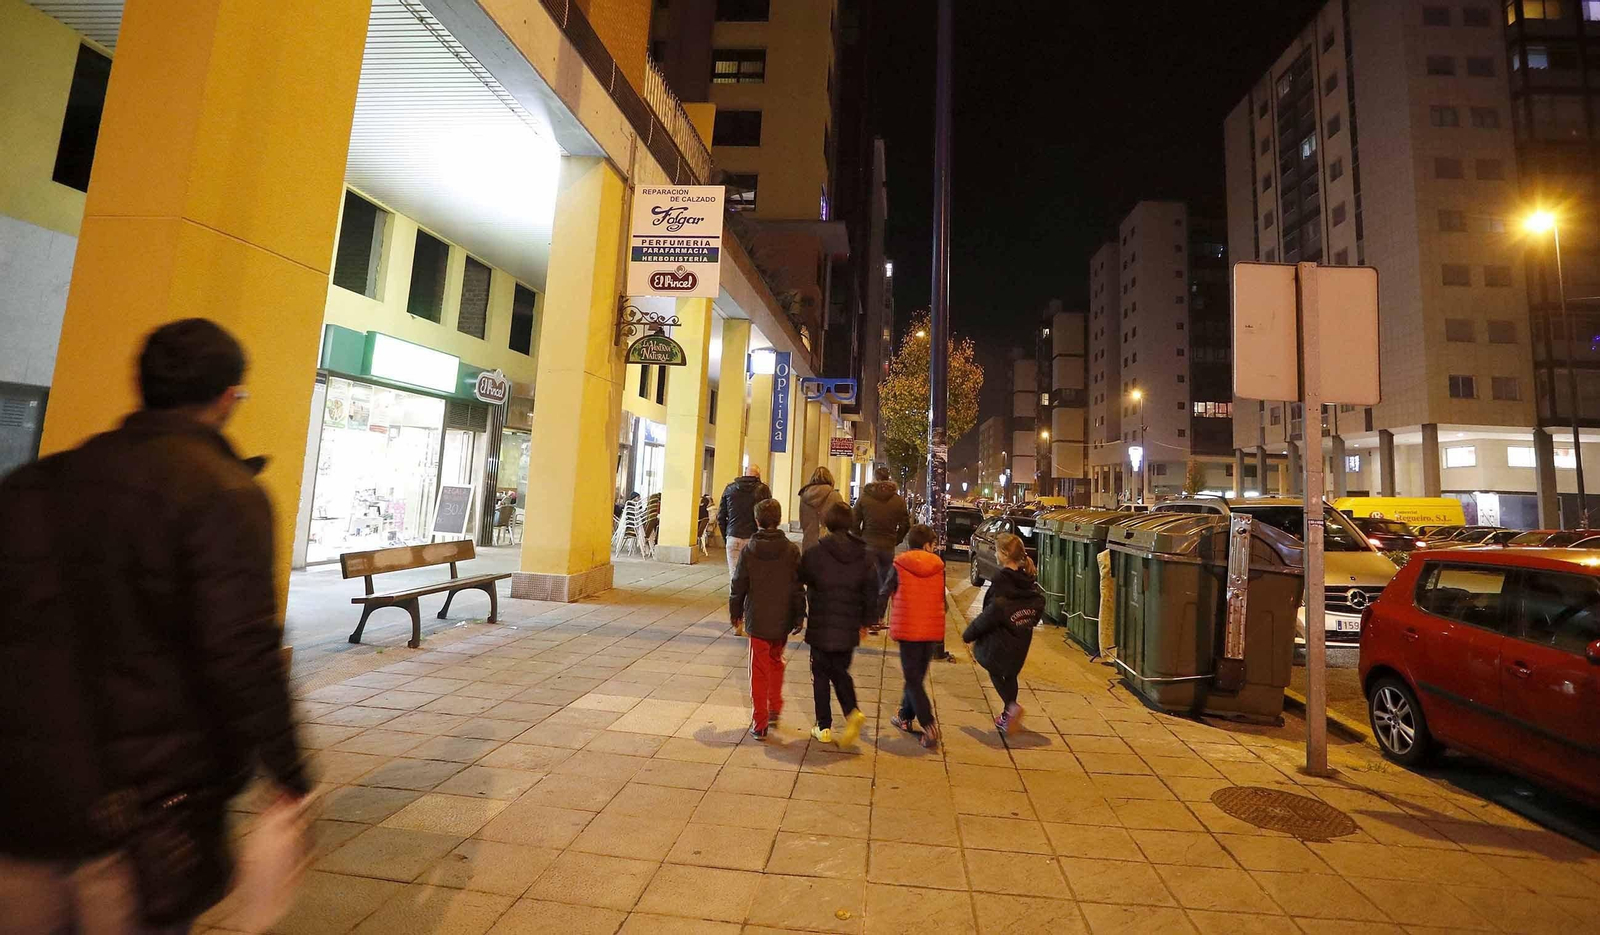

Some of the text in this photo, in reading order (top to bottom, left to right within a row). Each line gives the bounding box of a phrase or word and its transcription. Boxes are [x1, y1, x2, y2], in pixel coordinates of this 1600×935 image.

[651, 205, 705, 232] Folgar
[641, 239, 711, 247] PERFUMERÍA
[653, 274, 693, 288] El Pincel
[480, 377, 505, 398] El Pincel
